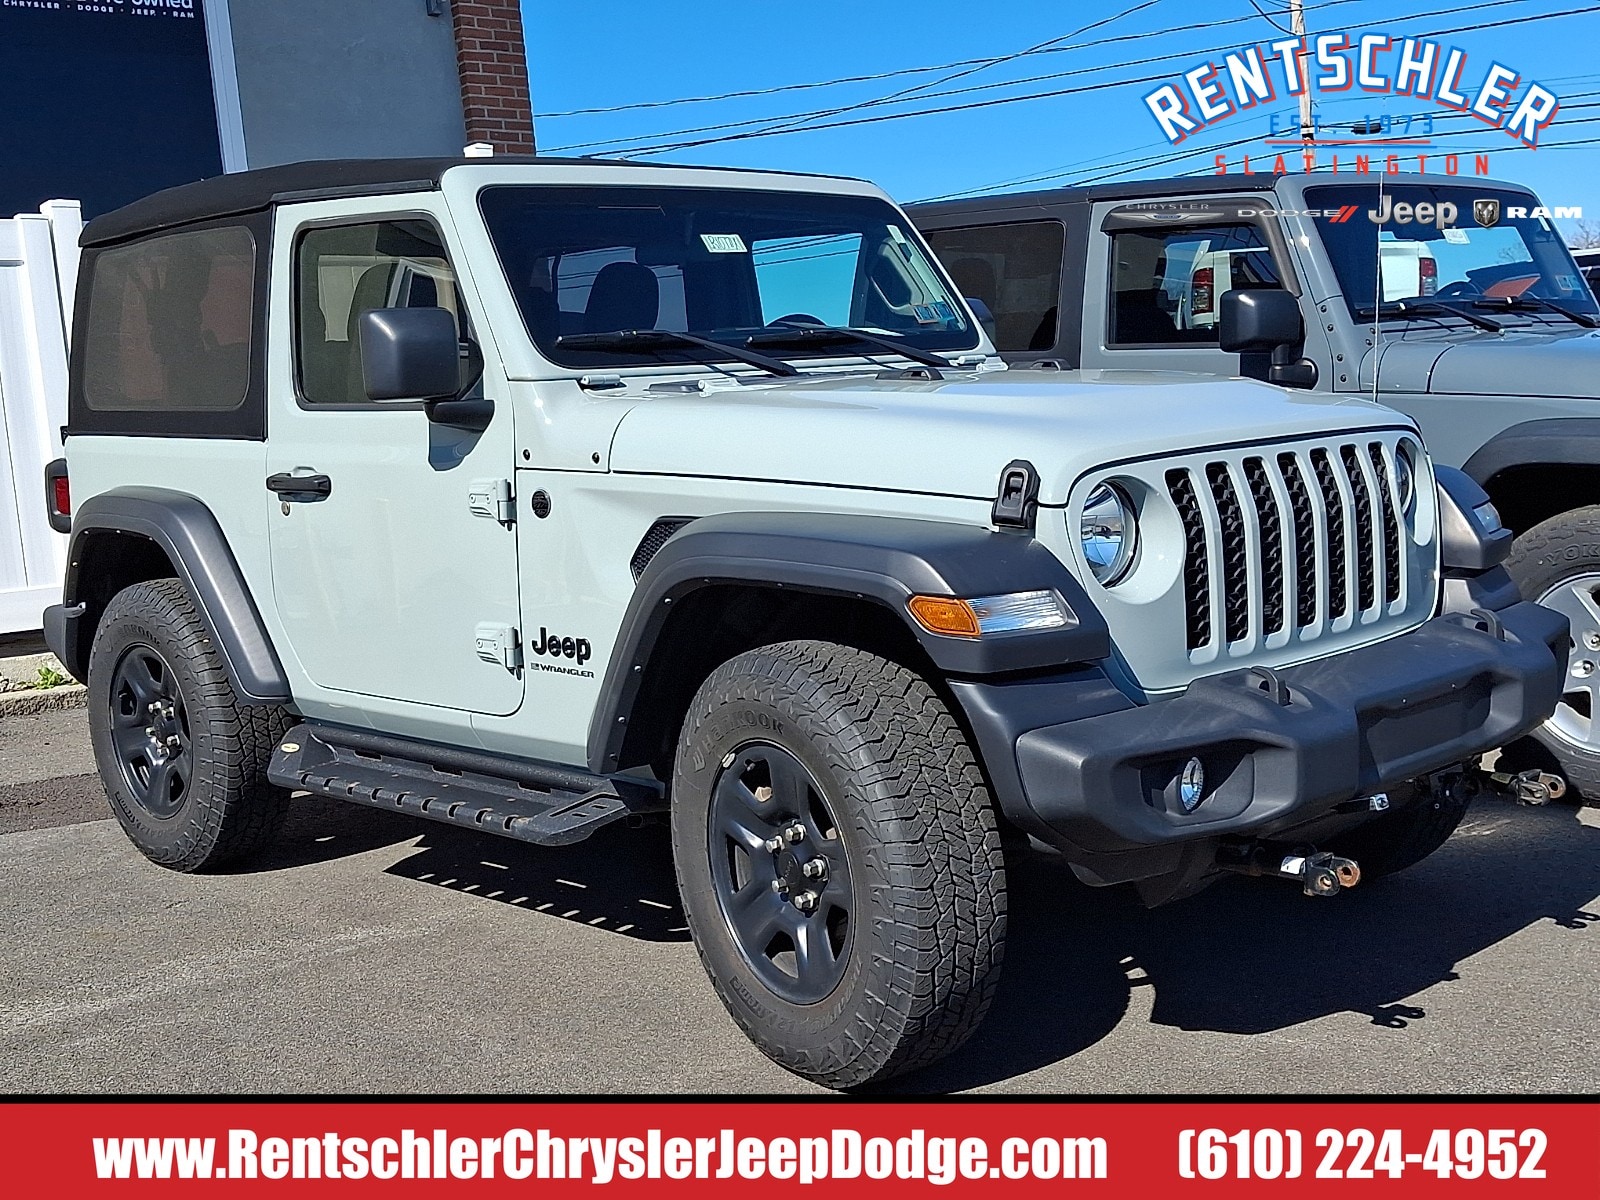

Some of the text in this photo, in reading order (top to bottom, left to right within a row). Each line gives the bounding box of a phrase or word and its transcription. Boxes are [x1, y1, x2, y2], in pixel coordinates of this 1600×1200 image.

[3, 0, 60, 9] CHRYSLER
[77, 4, 114, 13] DODGE
[173, 10, 194, 18] RAM
[532, 627, 592, 666] Jeep
[540, 663, 594, 679] WRANGLER
